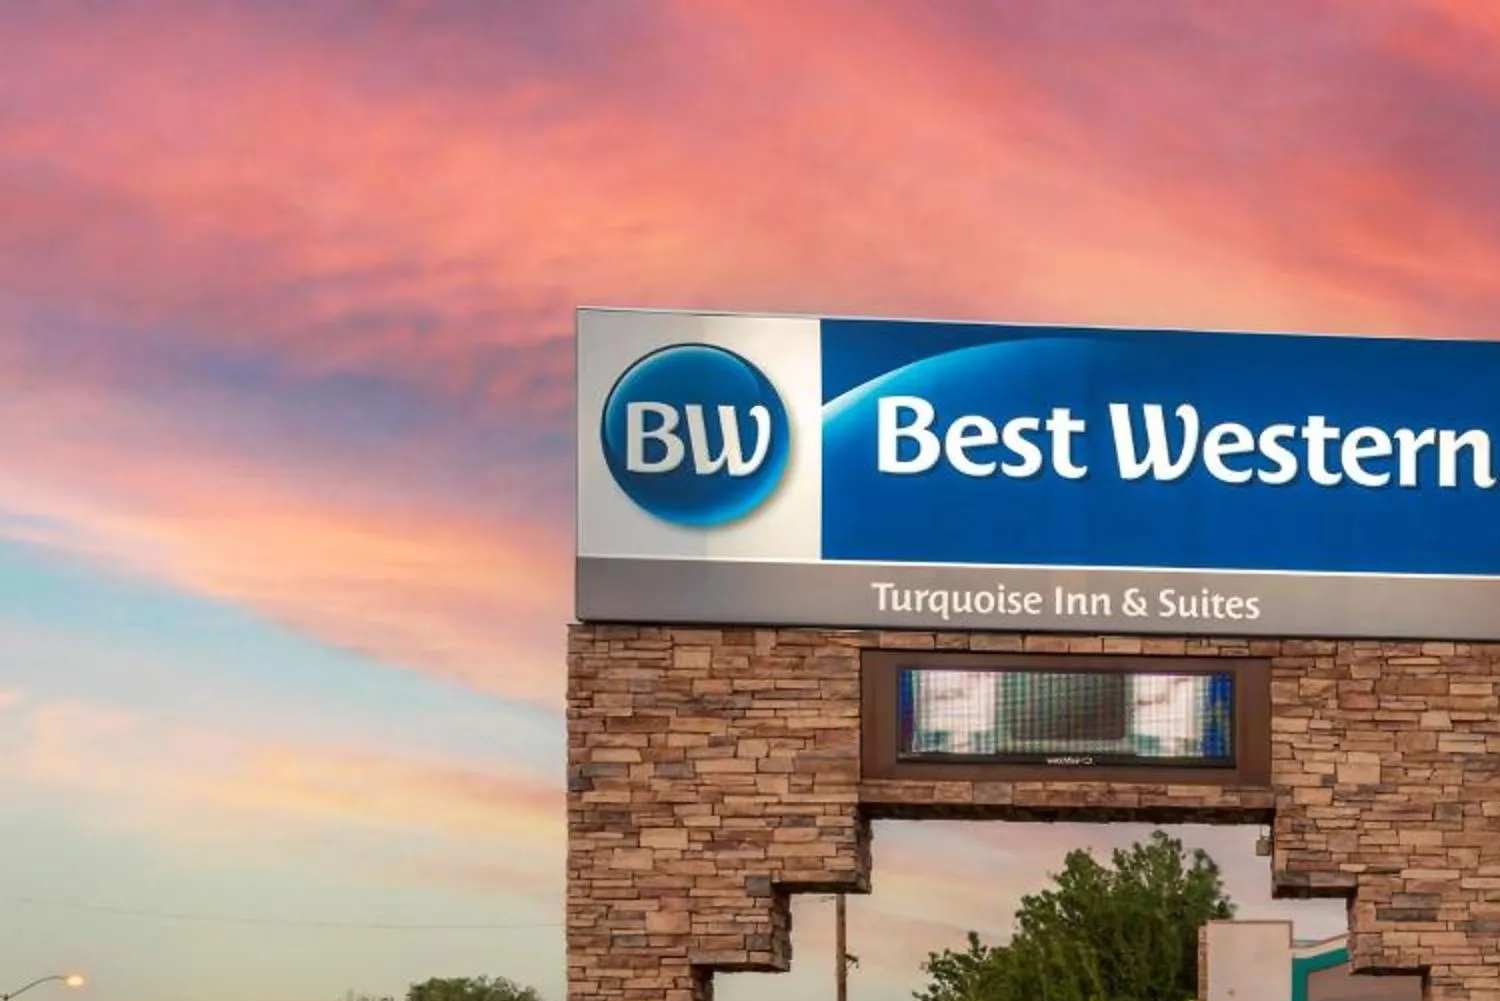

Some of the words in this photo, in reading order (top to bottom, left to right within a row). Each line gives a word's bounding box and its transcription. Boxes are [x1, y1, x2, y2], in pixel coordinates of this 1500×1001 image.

[627, 402, 771, 476] BW
[877, 395, 1088, 479] Best
[871, 582, 1043, 620] Turquoise
[1055, 586, 1111, 616] Inn
[1122, 587, 1147, 617] &
[1159, 589, 1261, 620] Suites
